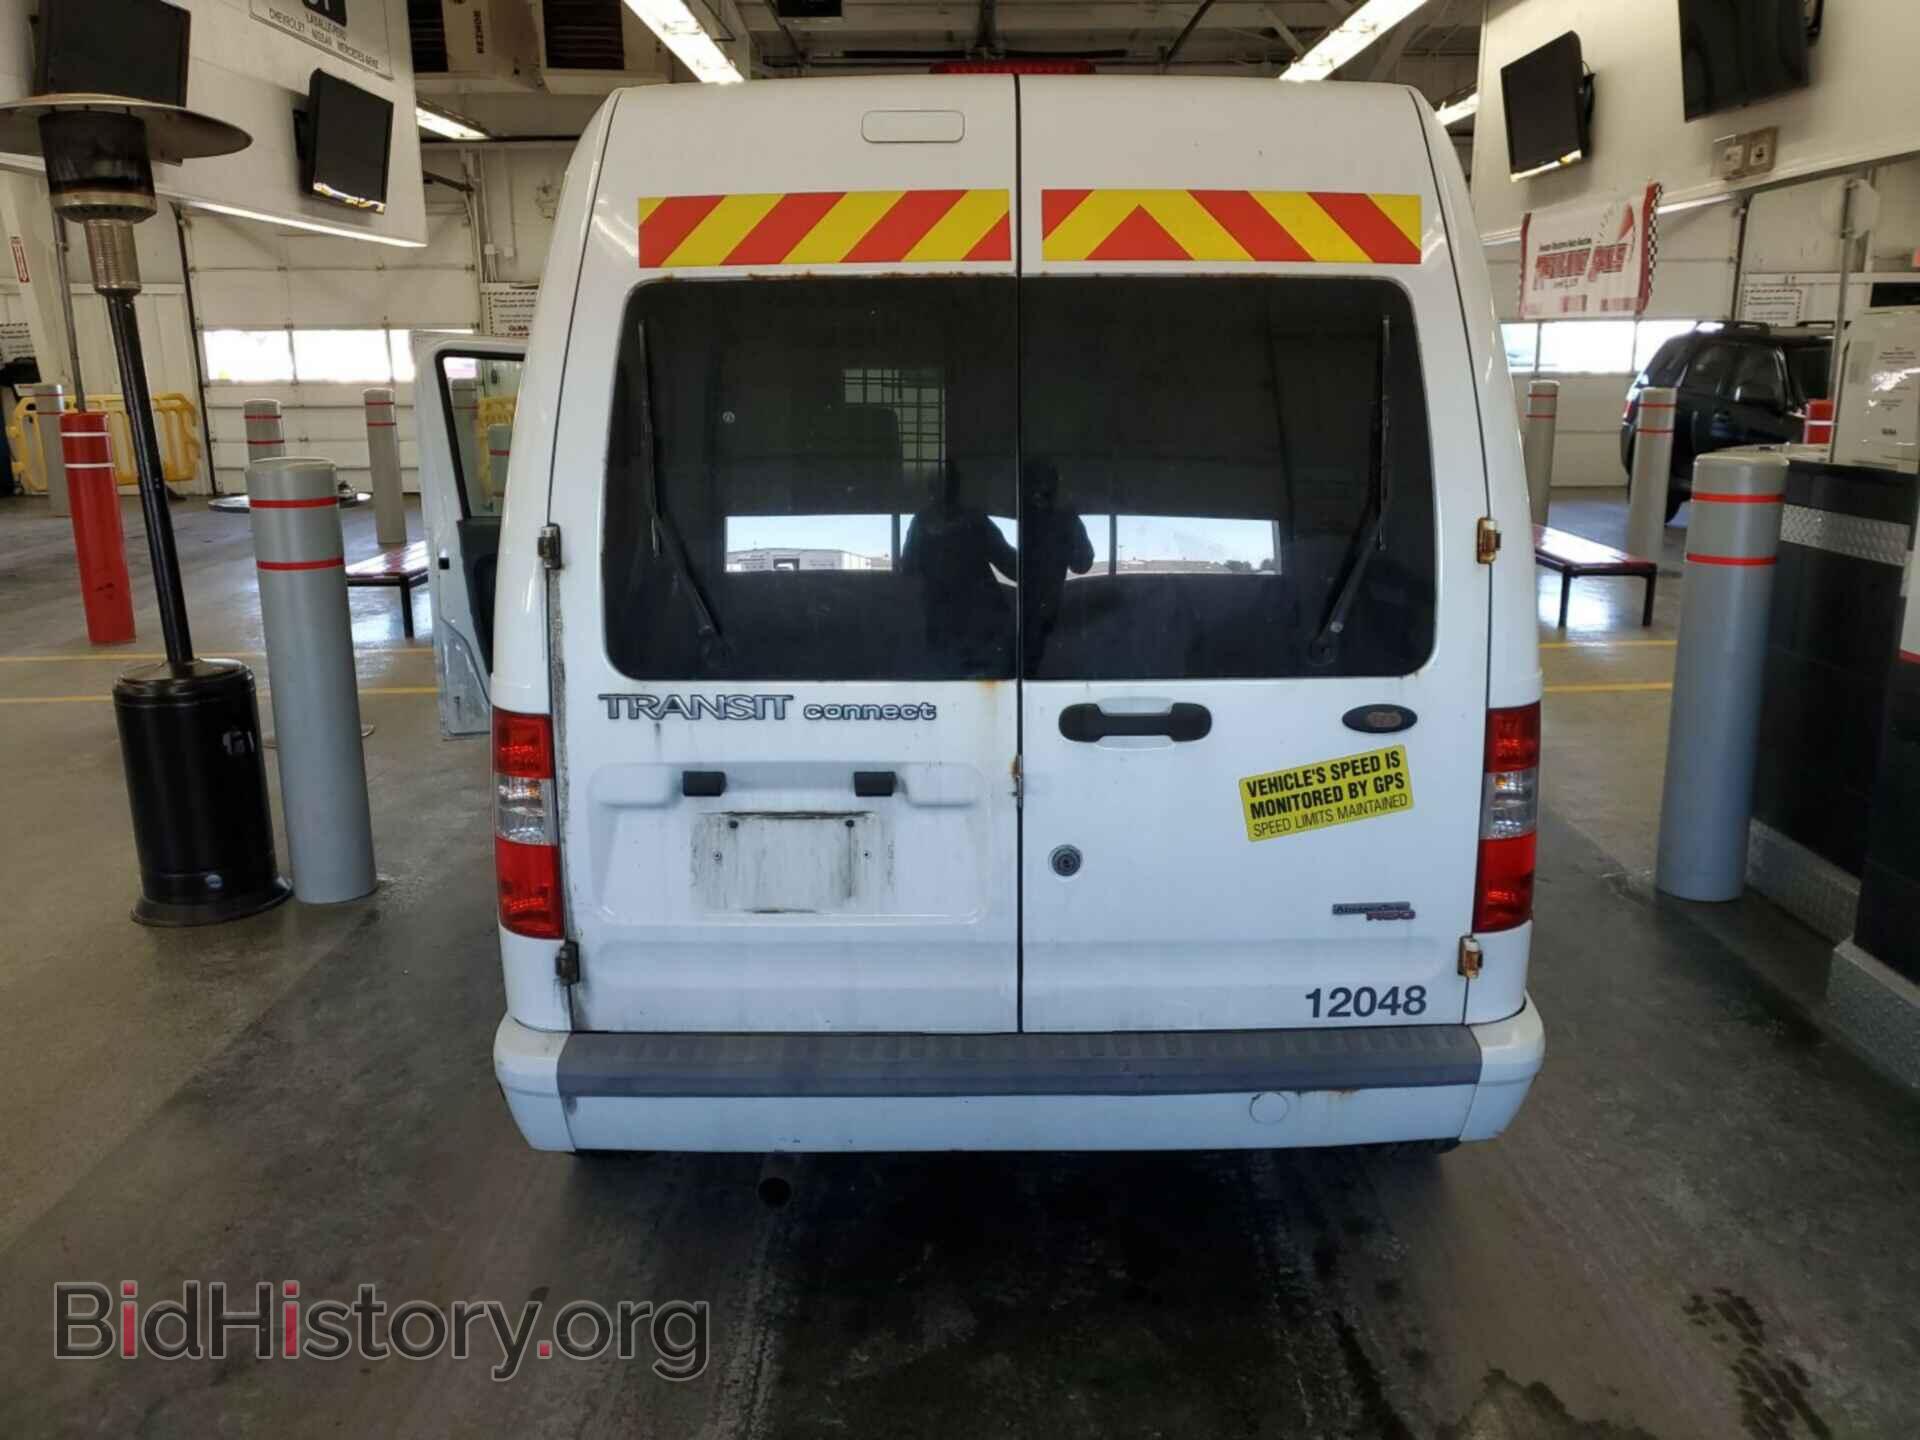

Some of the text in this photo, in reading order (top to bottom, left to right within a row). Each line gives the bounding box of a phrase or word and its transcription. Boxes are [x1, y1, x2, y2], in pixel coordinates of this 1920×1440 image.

[598, 694, 937, 721] TRANSIT connect
[1246, 751, 1401, 798] VEHICLE'S SPEED IS
[1250, 772, 1405, 820] MONITORED BY GPS
[1253, 793, 1408, 837] SPEED LIMITS MAINTAINED
[1305, 985, 1427, 1018] 12048
